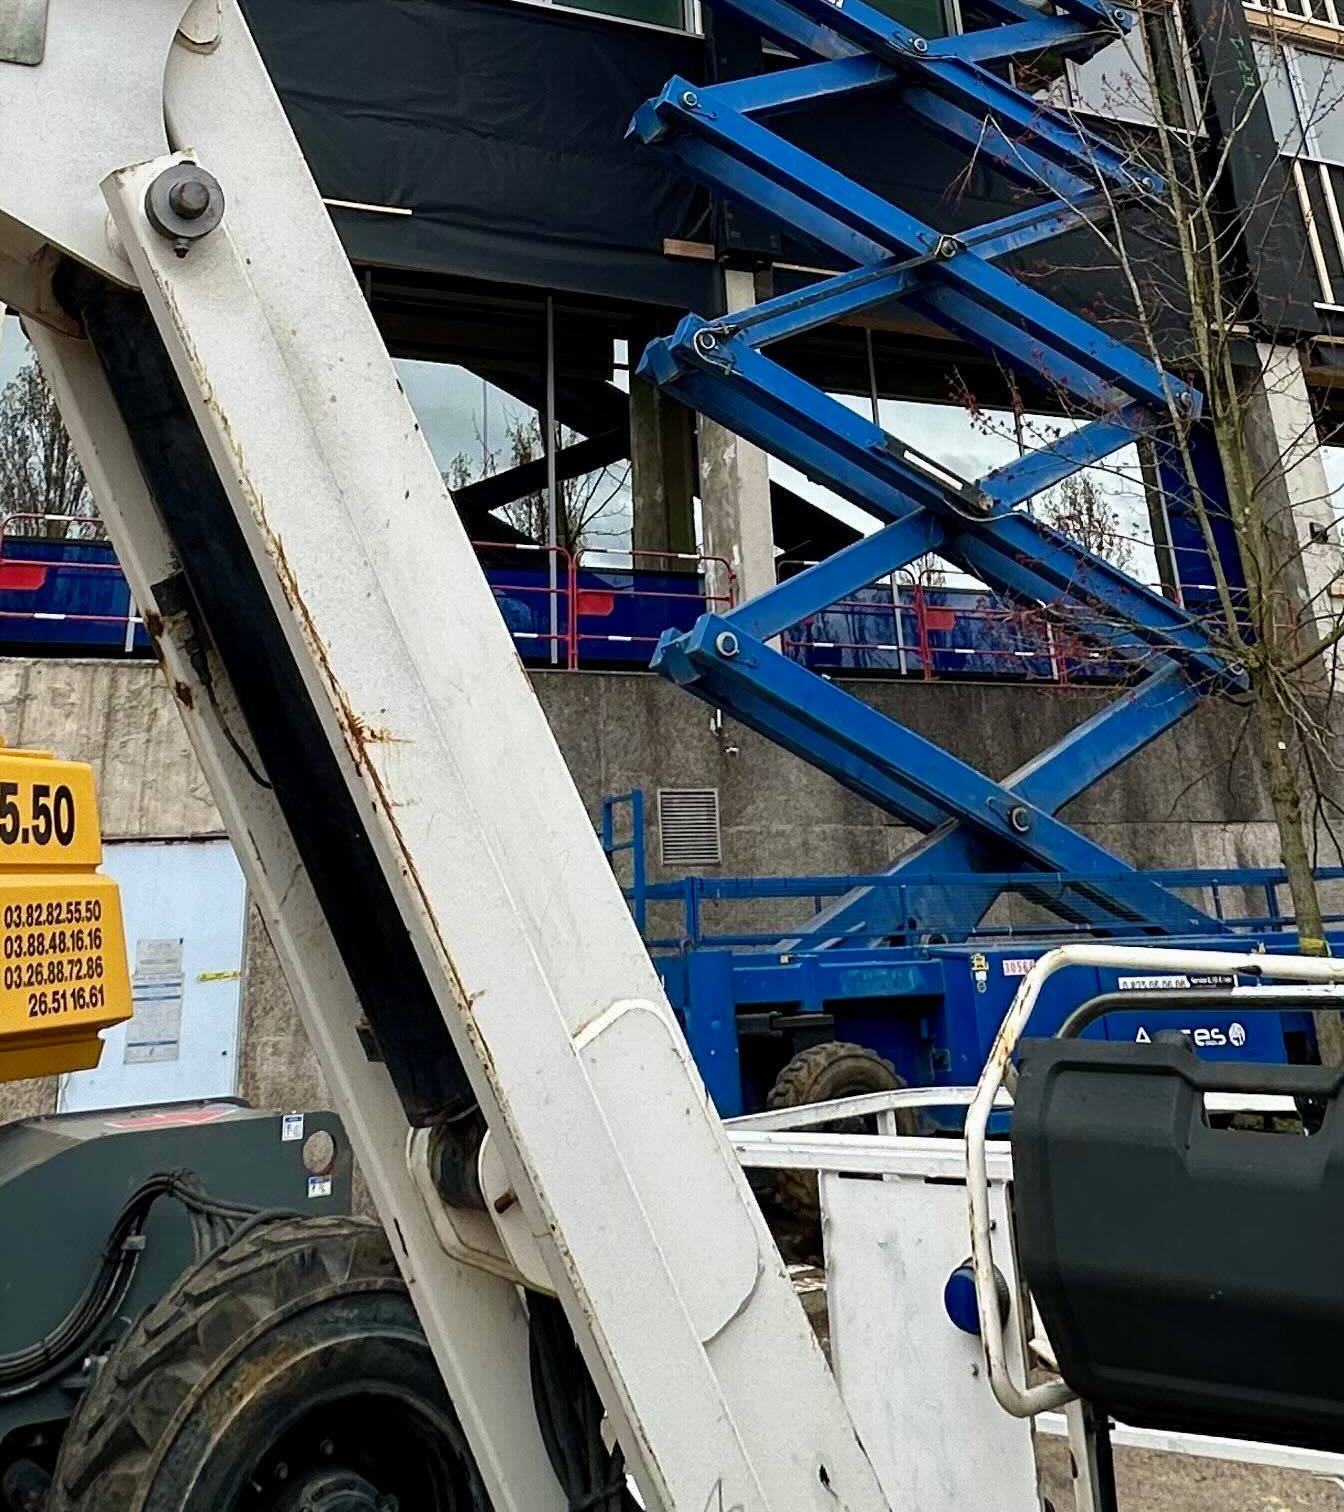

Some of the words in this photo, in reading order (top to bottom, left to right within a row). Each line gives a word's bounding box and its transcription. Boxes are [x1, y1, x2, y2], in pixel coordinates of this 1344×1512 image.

[3, 899, 102, 930] 03.82.82.55.50
[3, 927, 103, 960] 03.88.48.16.16
[4, 955, 104, 990] 03.26.88.72.86
[1135, 1027, 1227, 1047] Aes
